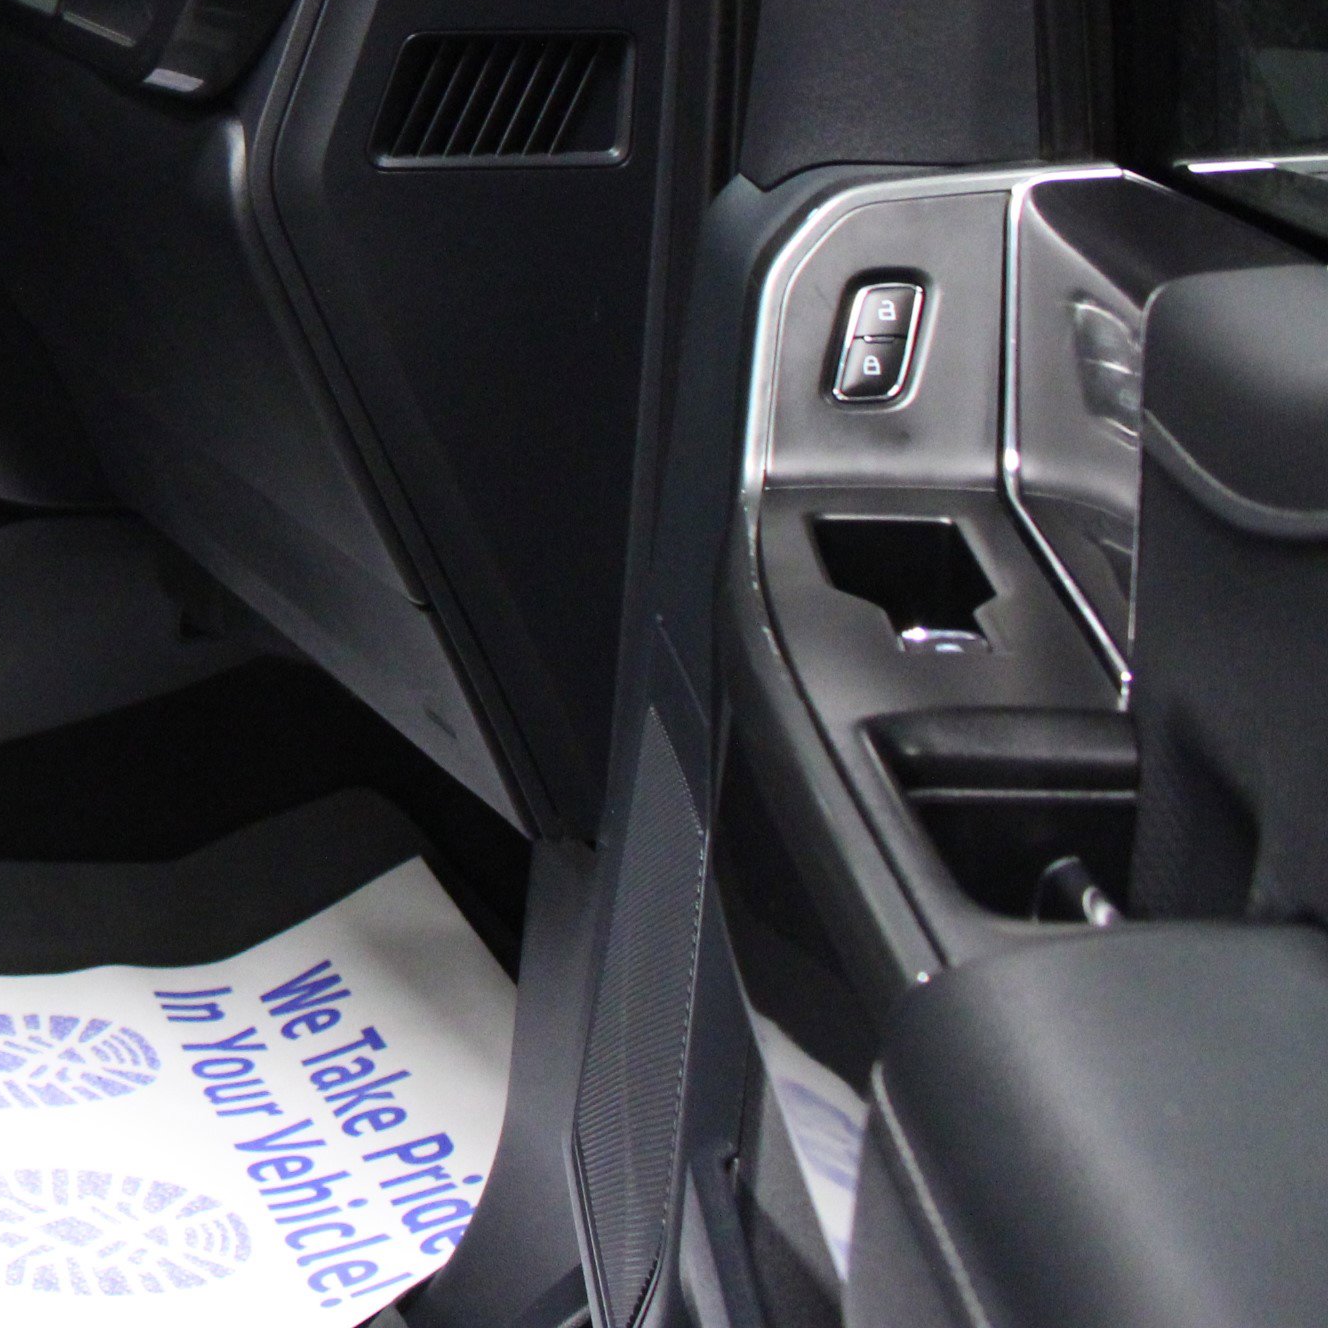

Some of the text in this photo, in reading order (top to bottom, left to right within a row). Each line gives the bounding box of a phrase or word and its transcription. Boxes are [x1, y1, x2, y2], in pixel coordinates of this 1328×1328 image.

[259, 959, 352, 1041] We
[300, 1025, 413, 1138] Take
[153, 986, 416, 1309] In Your Vehicle!
